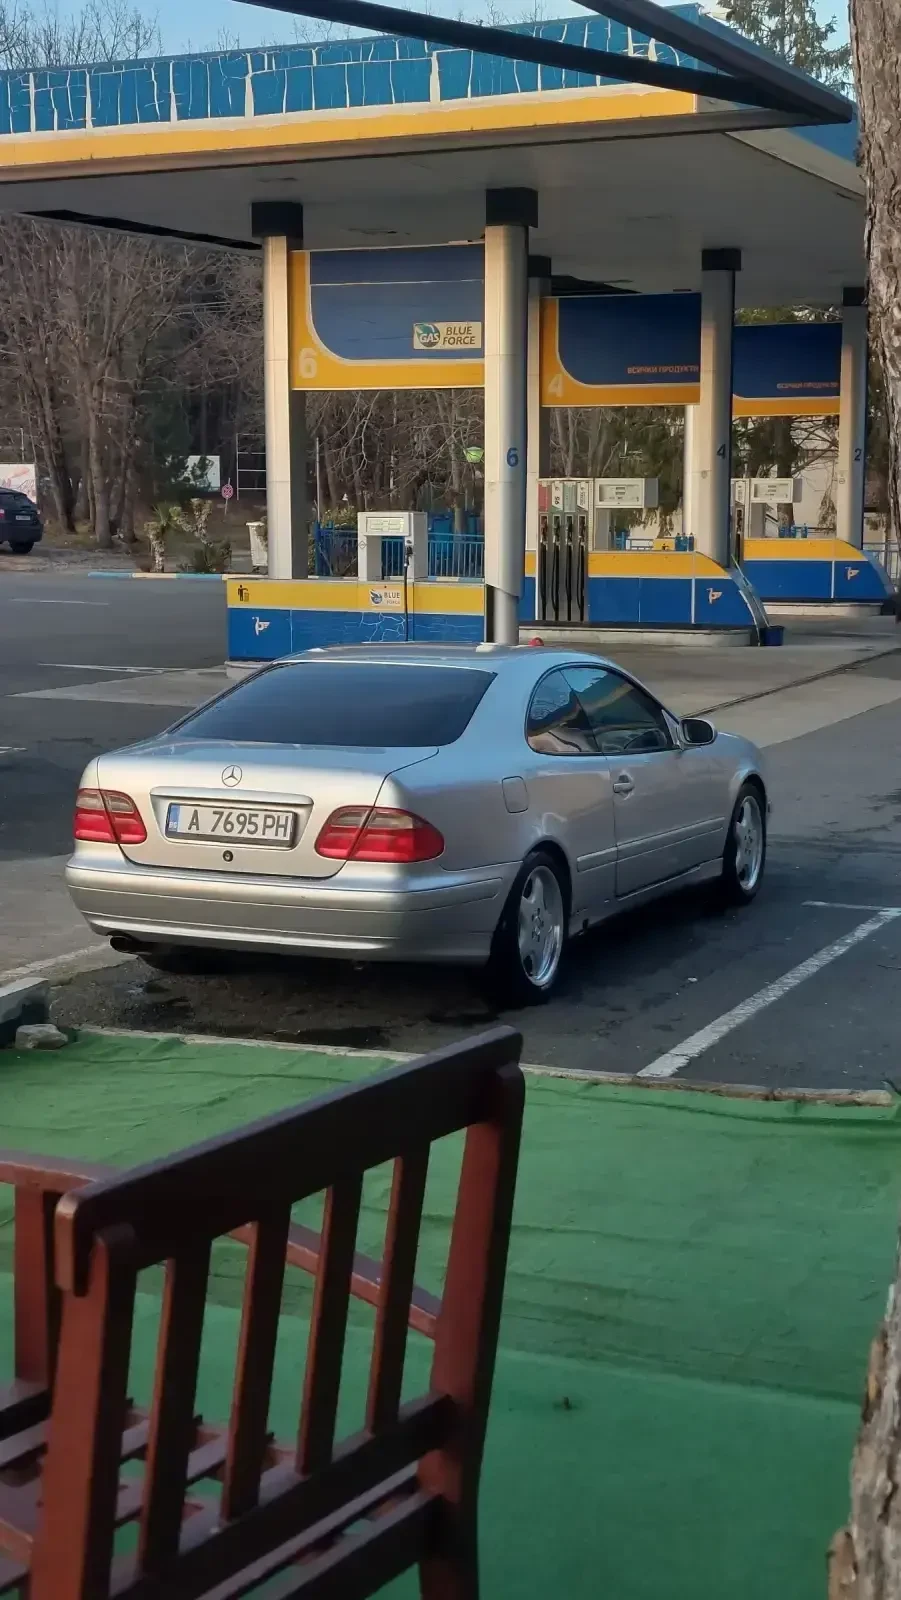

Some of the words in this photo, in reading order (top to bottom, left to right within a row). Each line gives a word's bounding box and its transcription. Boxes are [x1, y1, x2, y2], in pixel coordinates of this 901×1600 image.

[420, 333, 439, 342] GAS
[446, 326, 472, 335] BLUE
[443, 336, 476, 345] FORCE
[299, 348, 317, 379] 6
[547, 374, 563, 398] 4
[506, 447, 519, 467] 6
[717, 444, 726, 459] 4
[854, 448, 862, 461] 2
[187, 809, 200, 831] A
